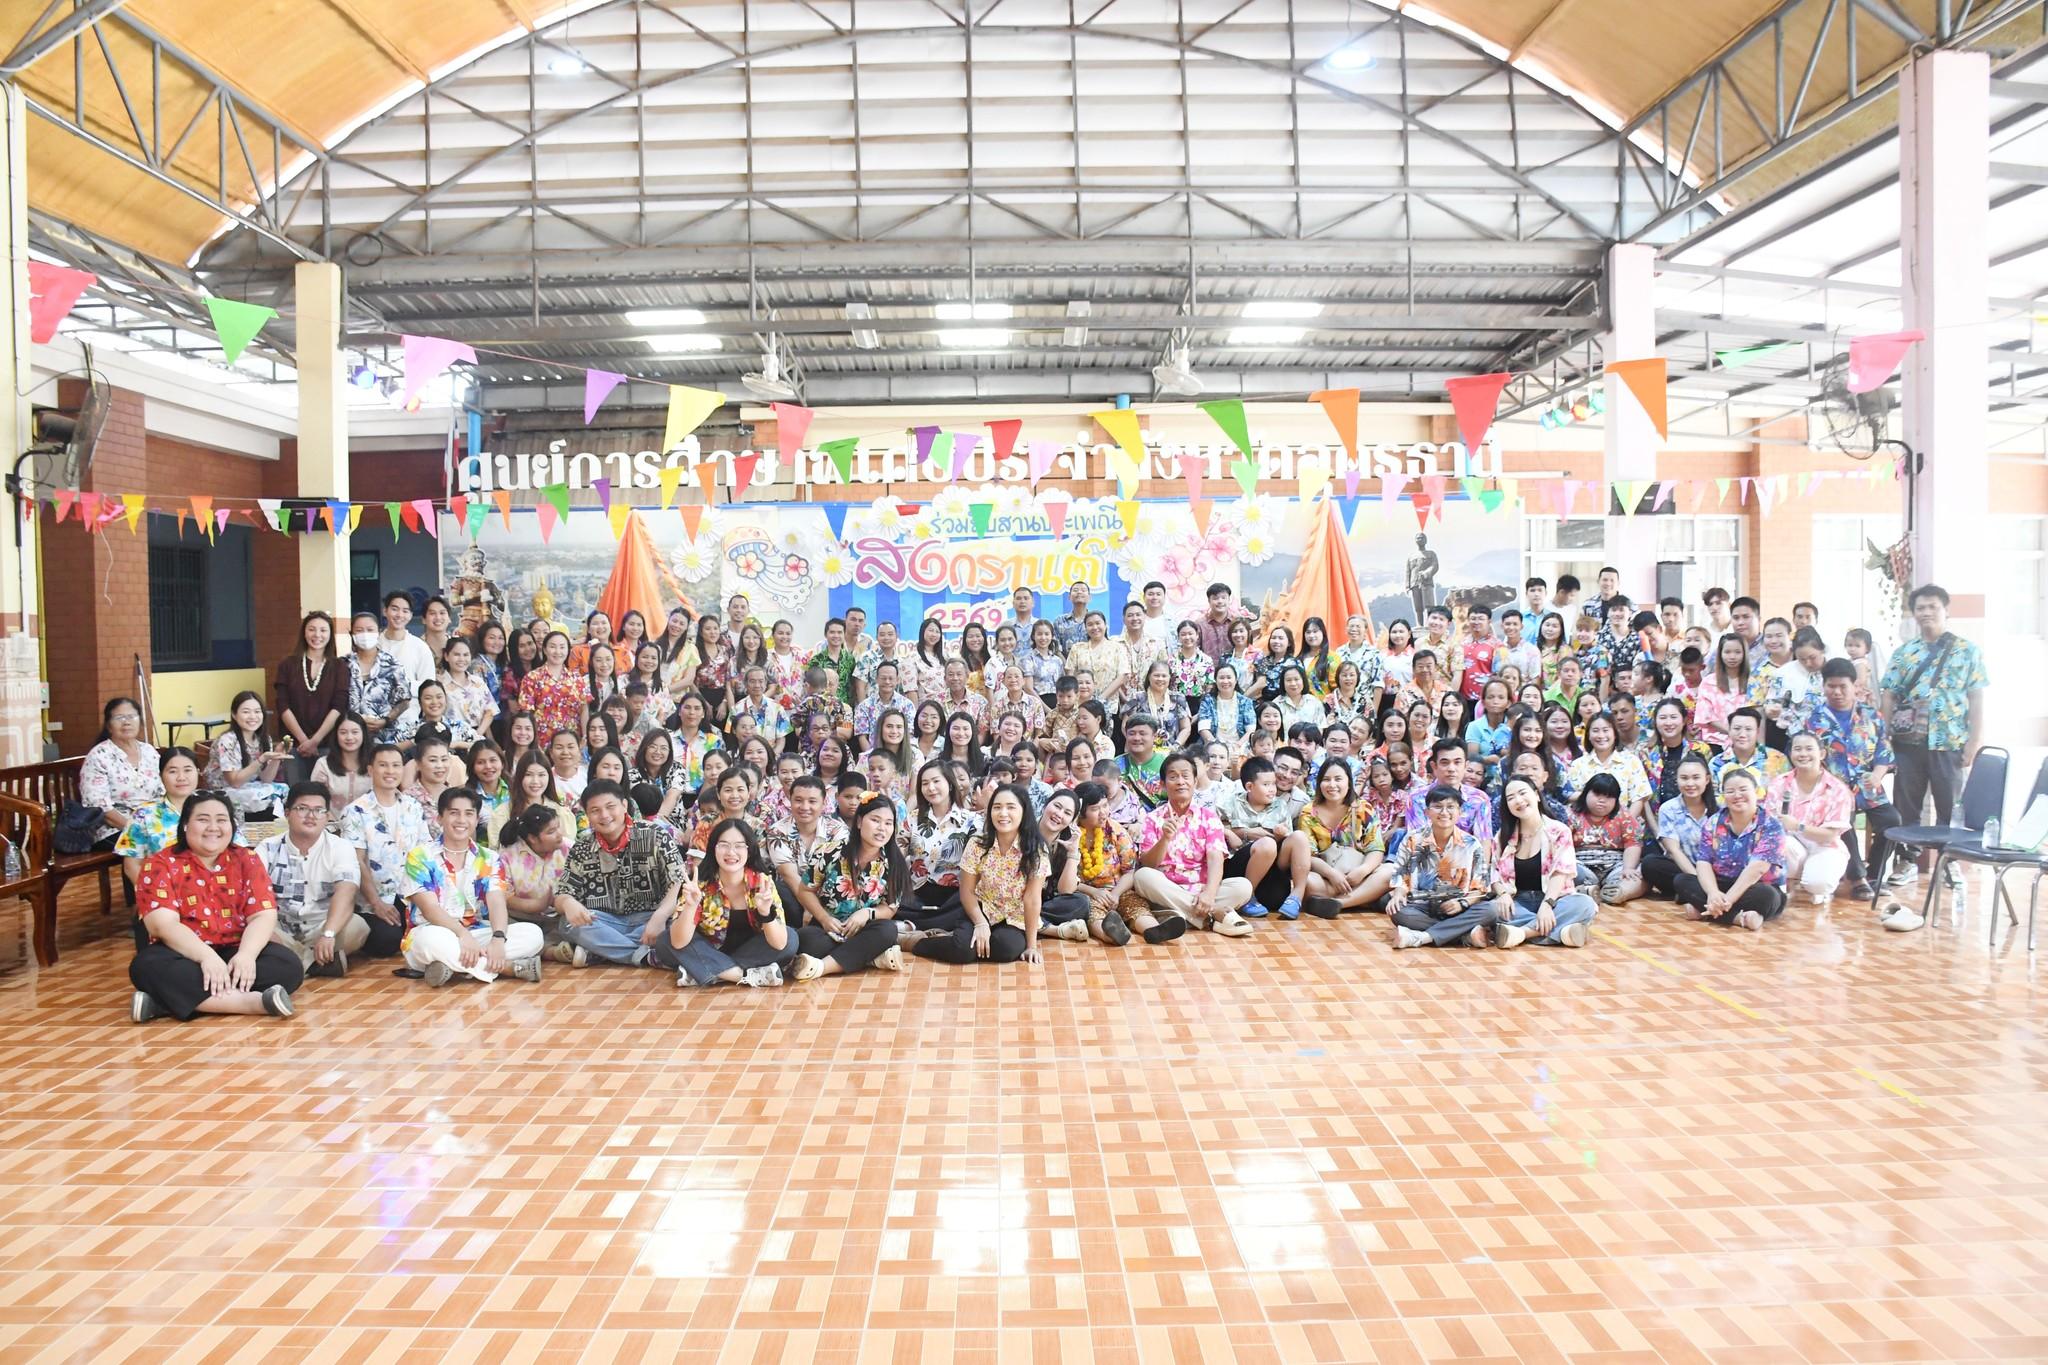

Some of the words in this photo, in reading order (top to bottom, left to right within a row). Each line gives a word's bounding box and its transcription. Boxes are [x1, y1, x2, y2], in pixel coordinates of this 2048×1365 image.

[855, 537, 1106, 592] สงกรานต์
[929, 608, 1002, 629] 2569
